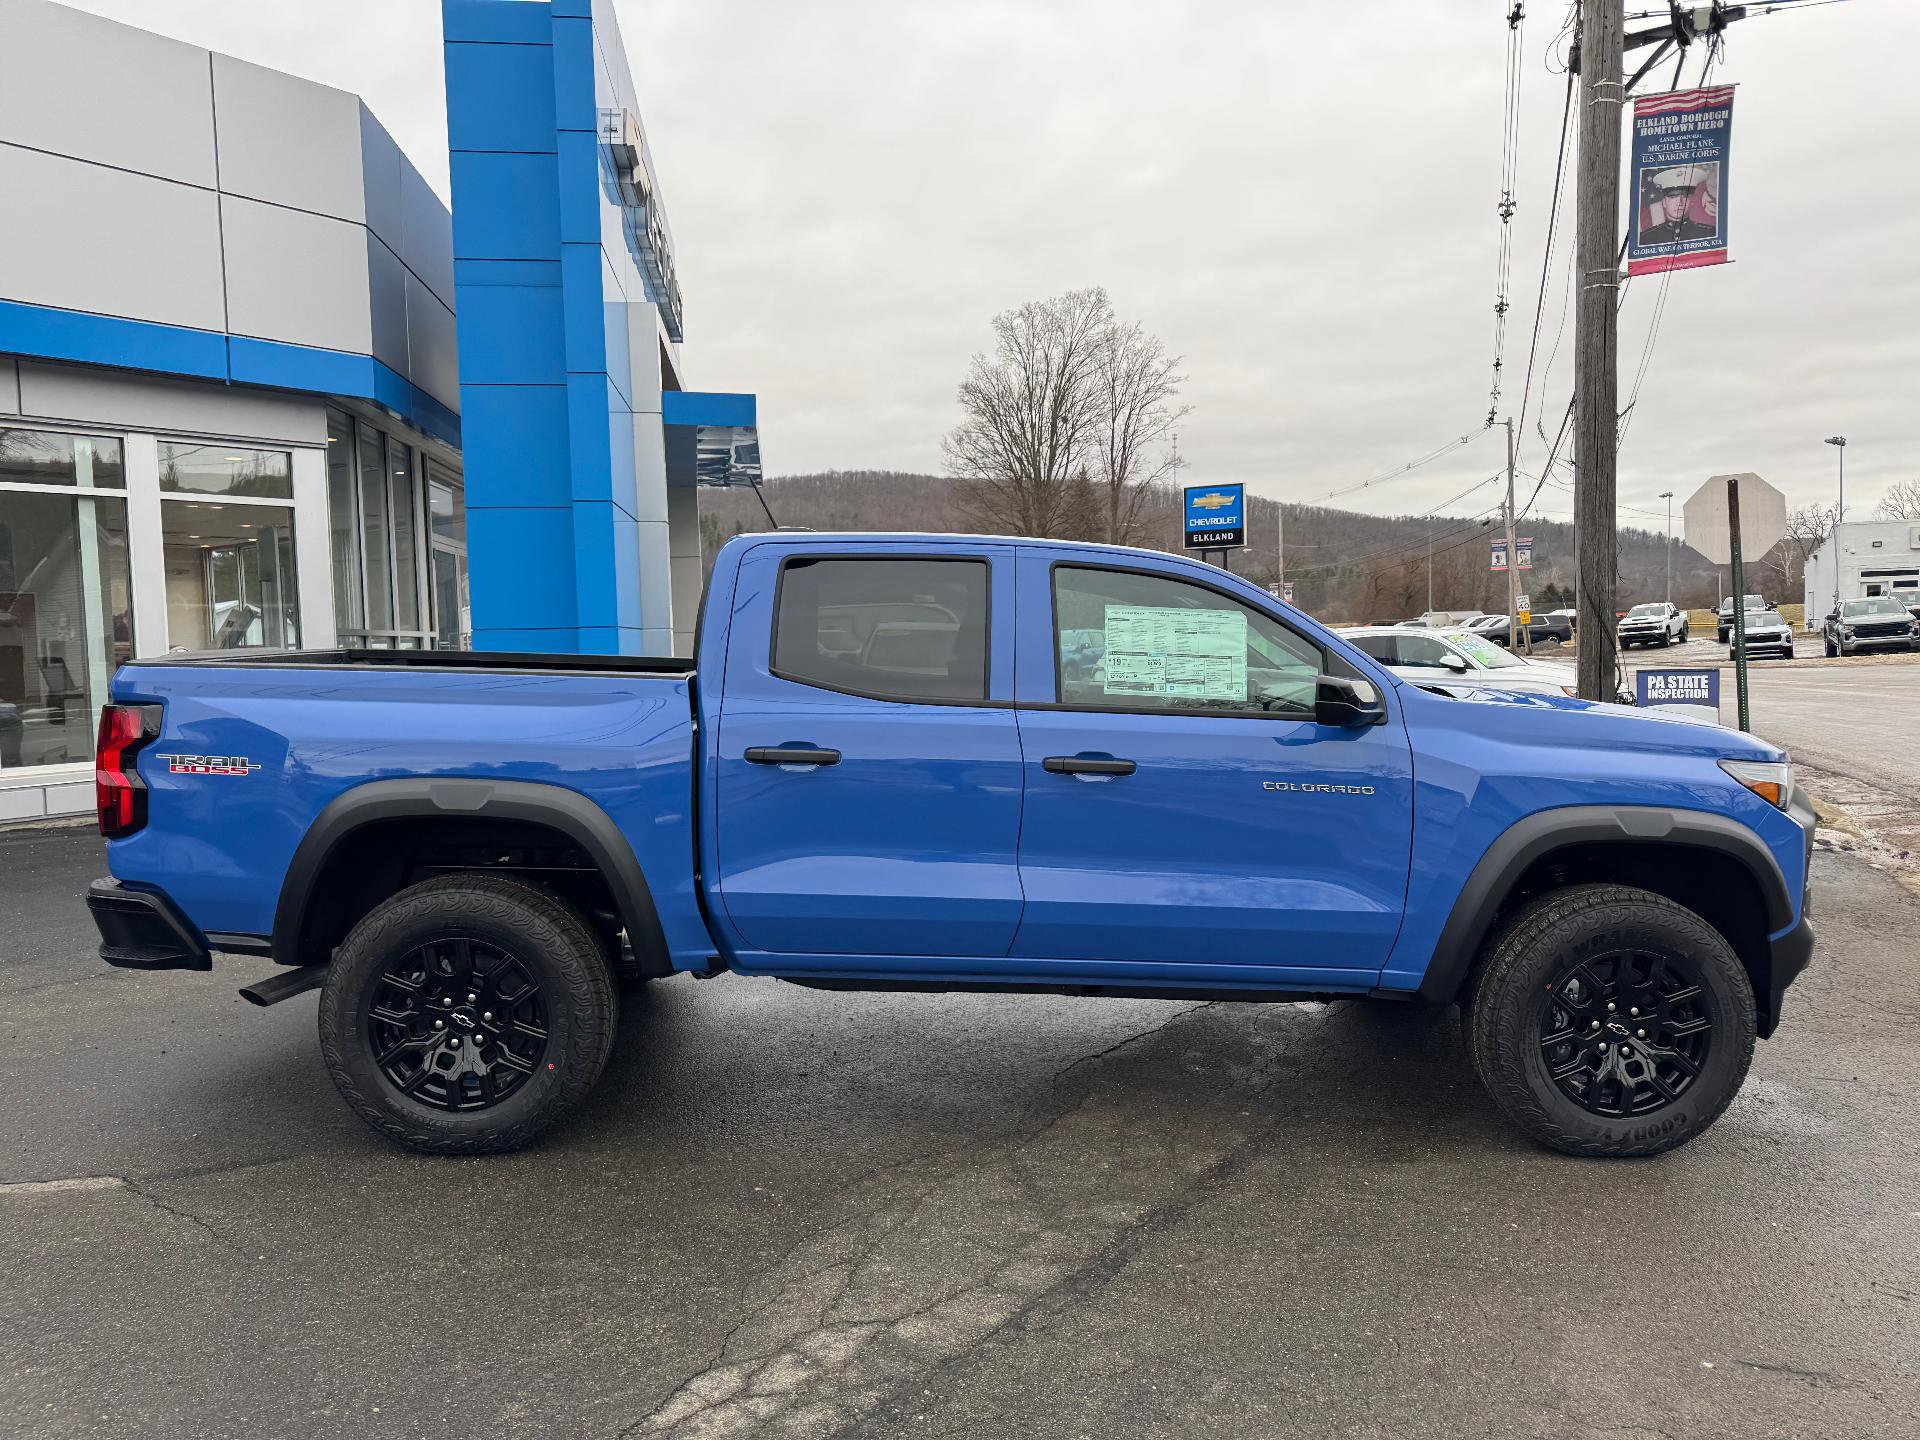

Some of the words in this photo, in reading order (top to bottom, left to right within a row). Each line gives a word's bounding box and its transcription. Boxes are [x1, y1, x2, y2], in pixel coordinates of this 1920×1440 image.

[1637, 115, 1678, 128] ELKLAND
[1681, 110, 1729, 123] BOROUGH
[1640, 123, 1695, 136] HOMETOWN
[1697, 119, 1724, 130] HERO
[1648, 142, 1685, 152] MICHAEL
[1657, 151, 1691, 161] MARINE
[1692, 148, 1719, 158] CORPS
[1633, 247, 1657, 255] GLOBAL
[1658, 245, 1670, 253] WAR
[1189, 516, 1237, 527] CHEVROLET
[1193, 532, 1234, 542] ELKLAND
[1518, 602, 1530, 610] 40
[1647, 675, 1665, 689] PA
[1667, 675, 1709, 689] STATE
[1647, 688, 1709, 699] INSPECTION
[155, 753, 262, 770] TRAIL
[169, 764, 249, 777] BOSS
[1262, 781, 1376, 795] COLORADO
